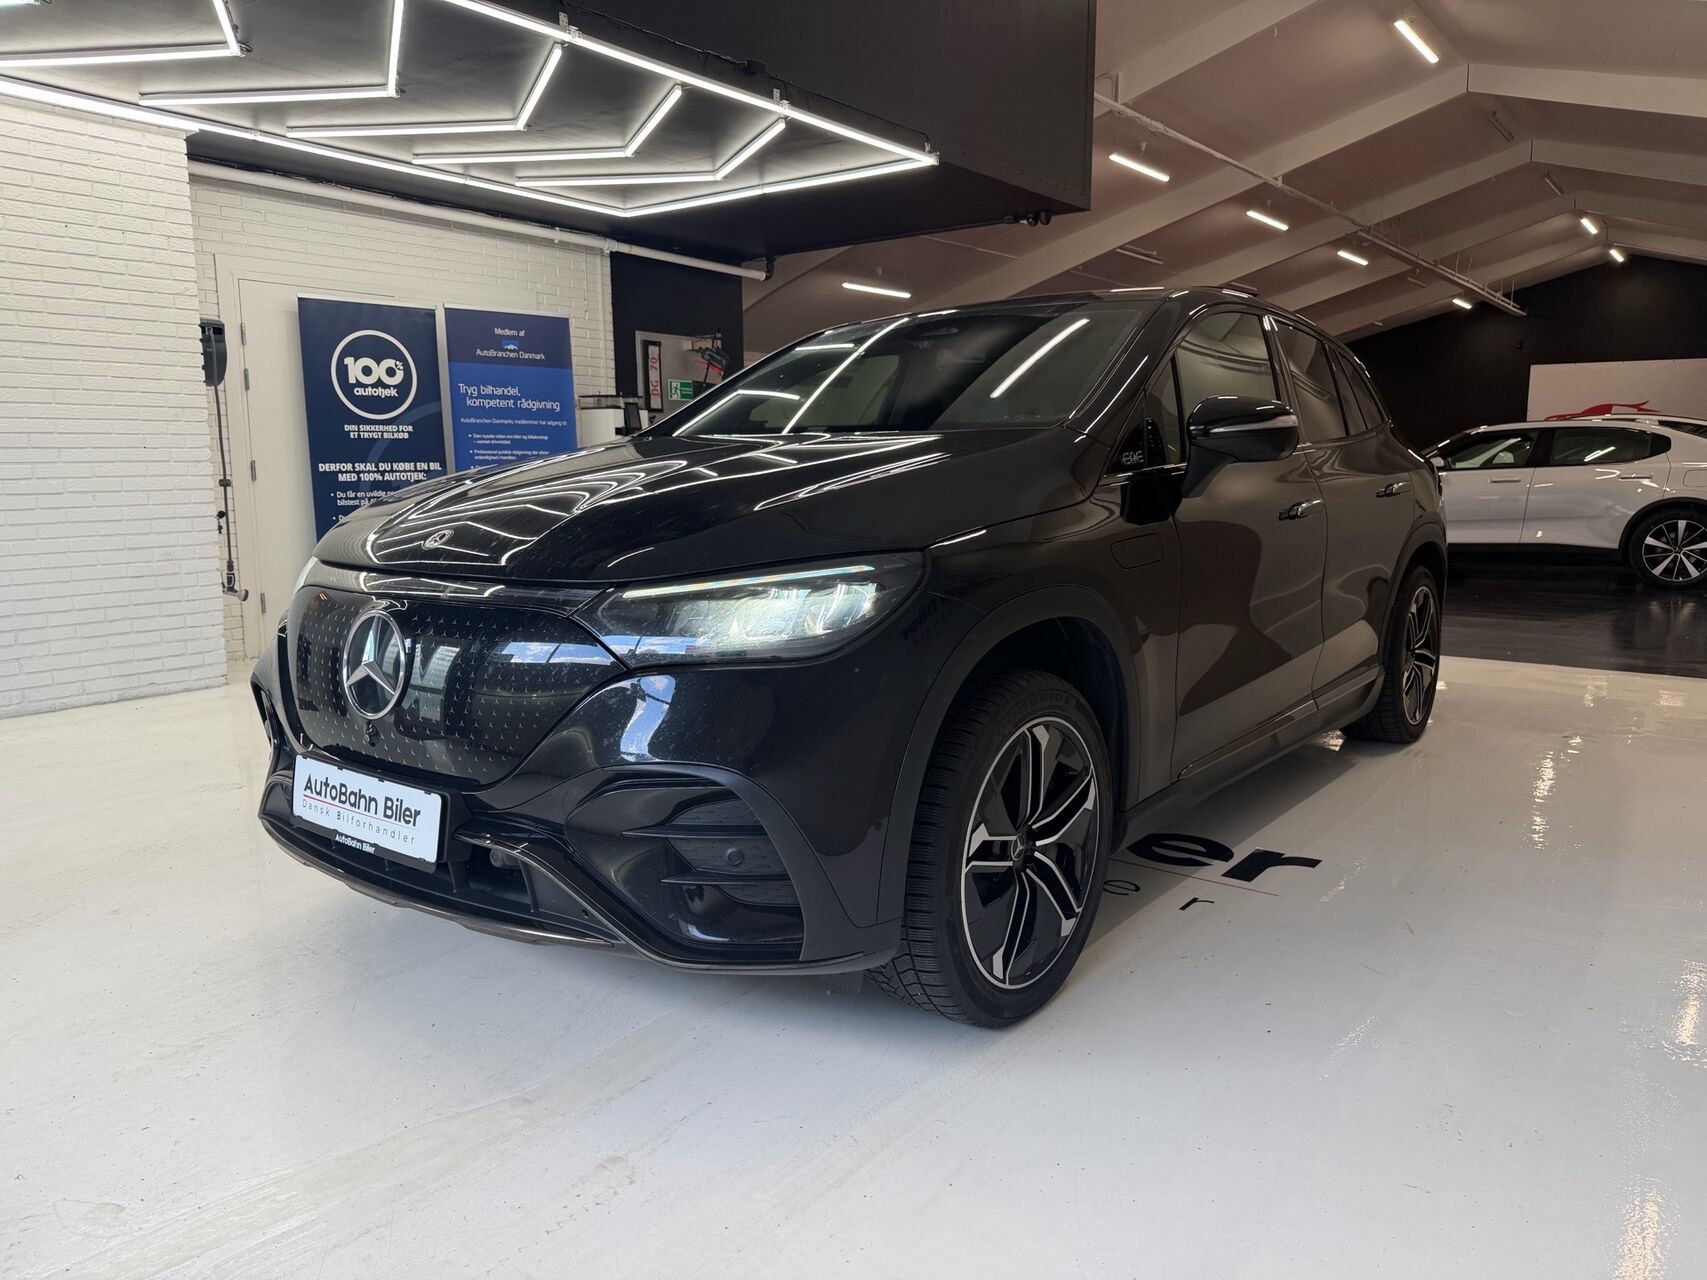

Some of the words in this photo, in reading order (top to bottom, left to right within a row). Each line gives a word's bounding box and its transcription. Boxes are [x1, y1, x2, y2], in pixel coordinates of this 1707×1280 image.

[494, 327, 517, 336] Medlem
[519, 329, 525, 337] af
[476, 348, 518, 358] AutoBranchen
[519, 351, 545, 360] Danmark
[353, 386, 398, 398] autotjek
[458, 383, 478, 396] Tryg
[480, 384, 521, 396] bilhandel,
[466, 397, 515, 409] kompetent
[517, 398, 560, 412] rådgivning
[344, 424, 358, 432] DIN
[359, 424, 398, 432] SIKKERHED
[350, 431, 358, 439] ET
[318, 463, 353, 472] DERFOR
[354, 463, 378, 471] SKAL
[378, 462, 391, 471] DU
[392, 462, 415, 471] KØBE
[416, 462, 428, 471] EN
[429, 462, 442, 470] BIL
[337, 473, 358, 482] MED
[359, 473, 383, 481] 100%
[383, 472, 427, 482] AUTOTJEK:
[346, 490, 356, 498] får
[304, 774, 378, 815] AutoBahn
[383, 795, 421, 827] Biler
[302, 799, 330, 817] Dansk
[337, 811, 415, 844] Bilforhandler
[335, 834, 362, 849] AutoBahn
[362, 843, 376, 855] Biler
